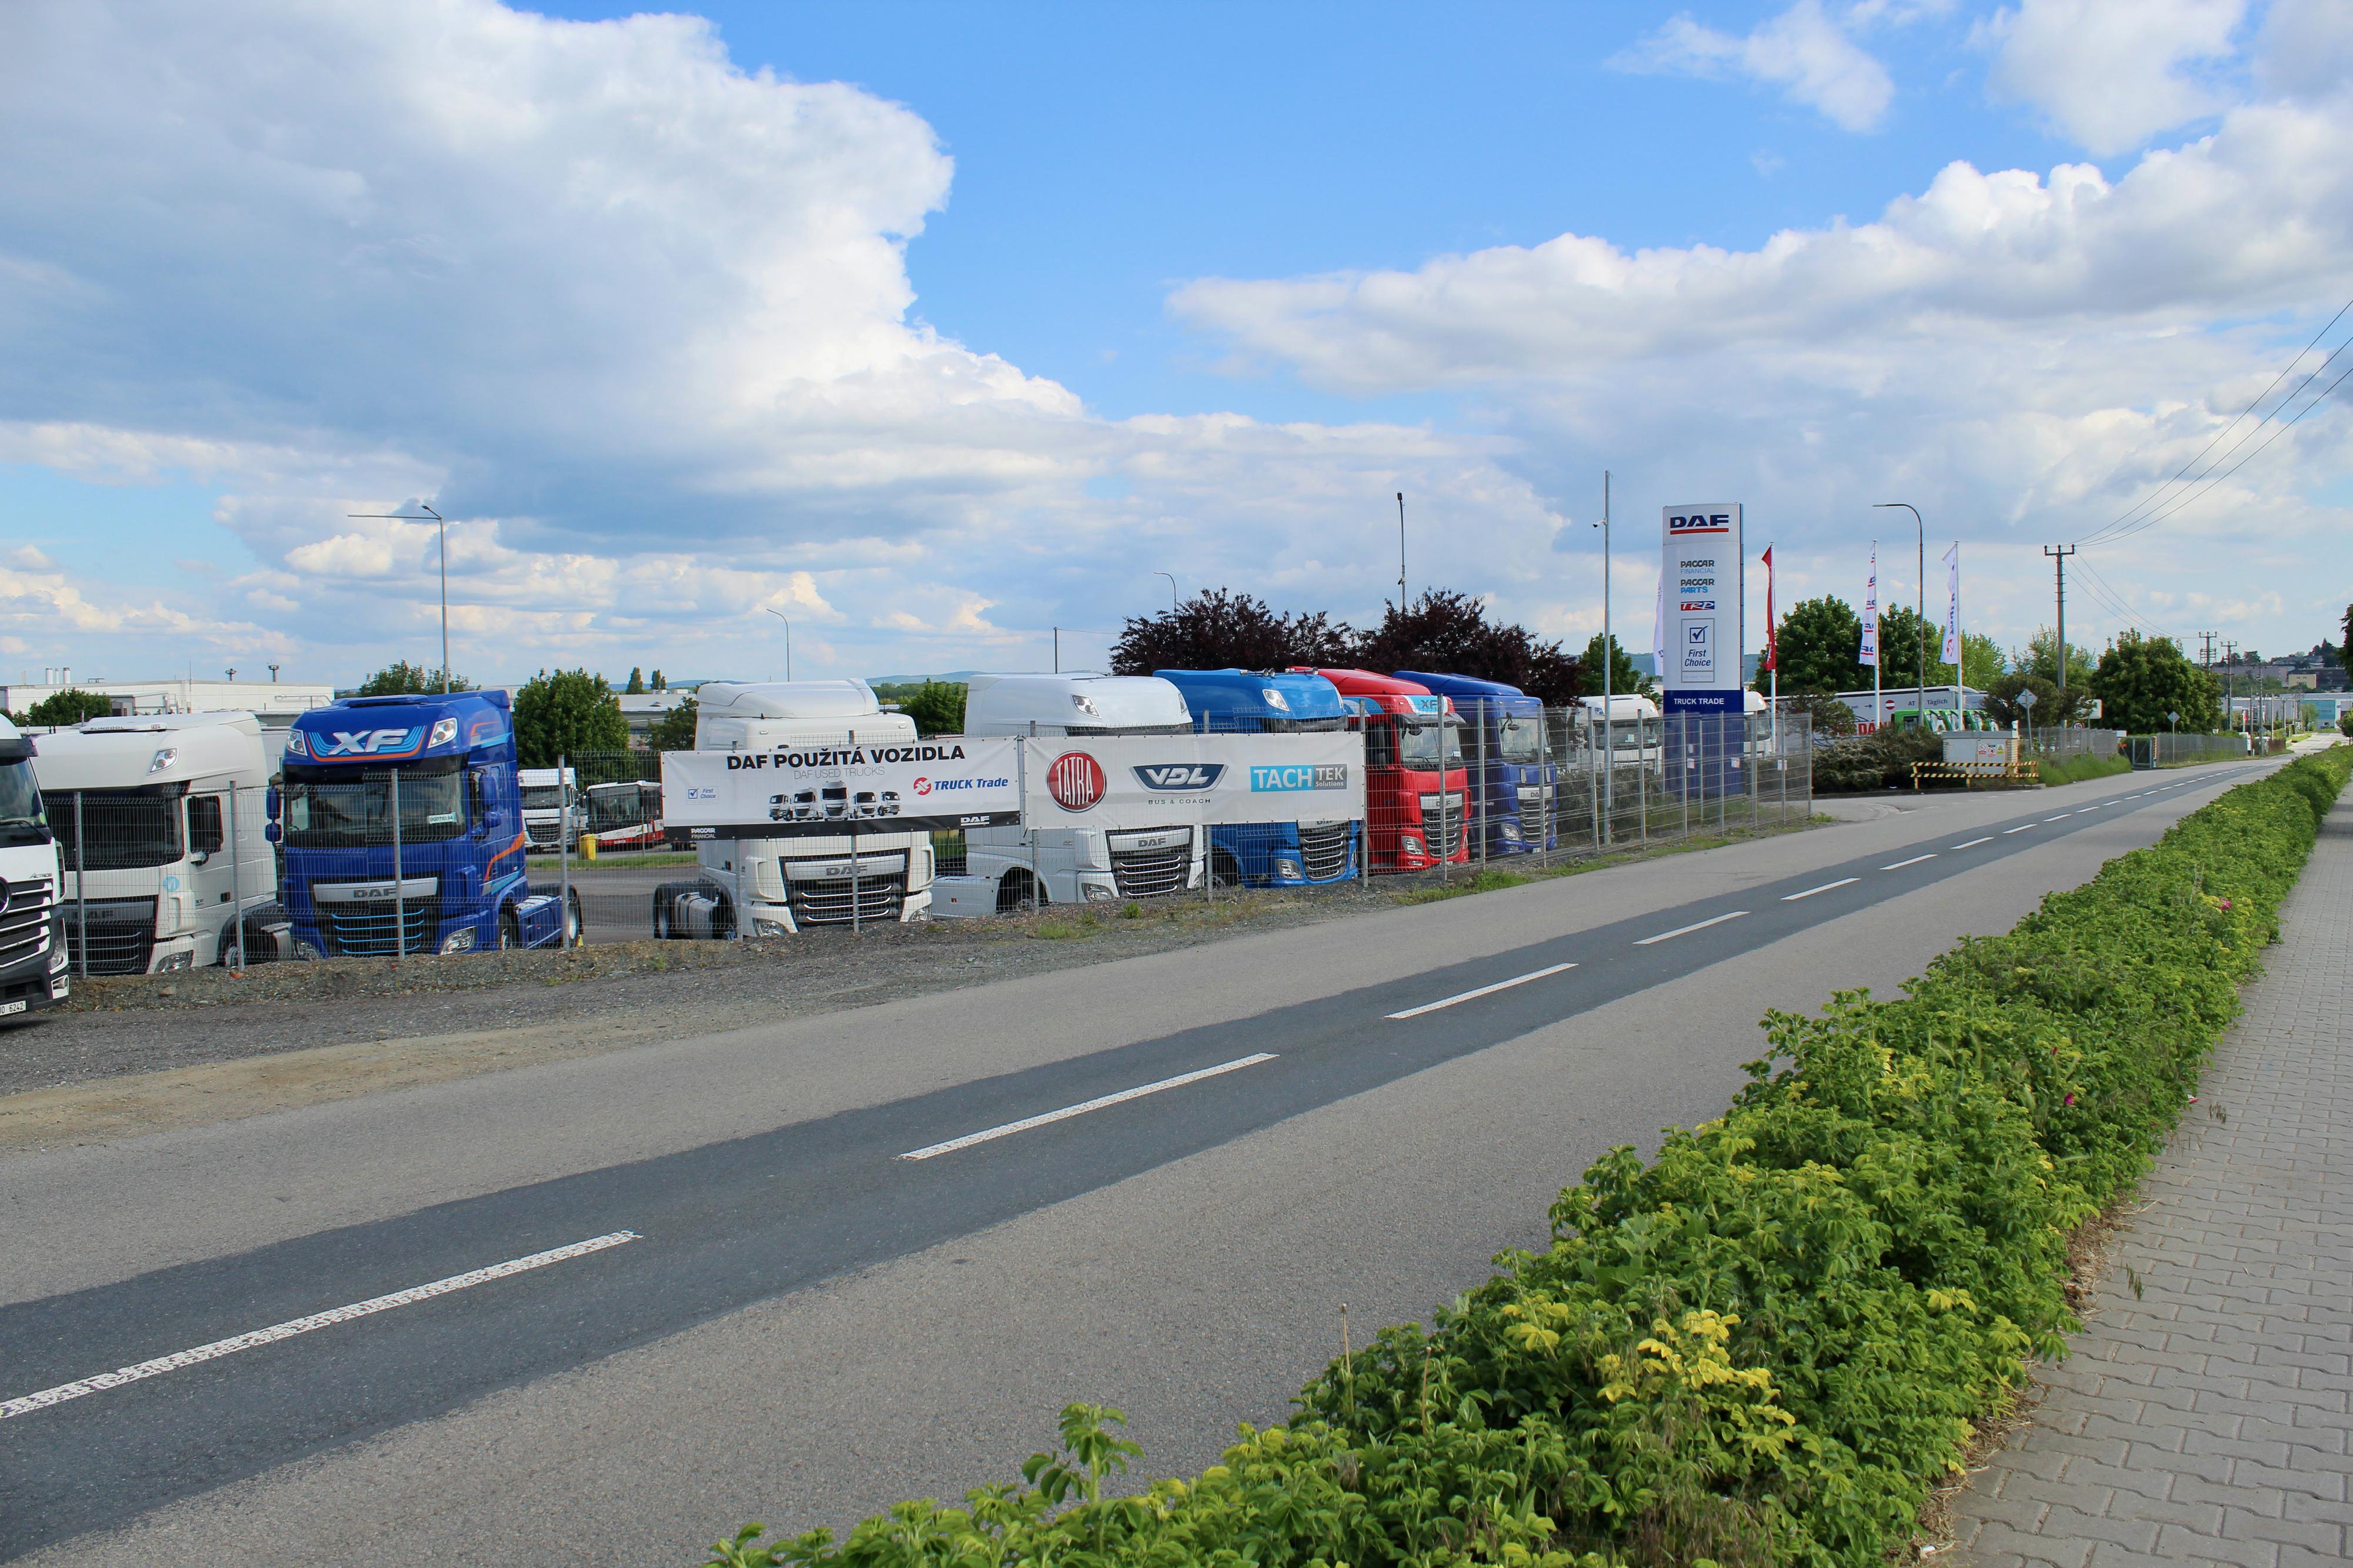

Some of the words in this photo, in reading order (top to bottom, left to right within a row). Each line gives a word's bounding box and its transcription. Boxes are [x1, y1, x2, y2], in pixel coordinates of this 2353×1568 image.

[1670, 515, 1729, 529] DAF
[1681, 602, 1715, 610] TRP
[327, 729, 409, 755] XF
[727, 755, 767, 770] DAF
[774, 746, 866, 768] POUŽITÁ
[871, 745, 965, 763] VOZIDLA
[794, 770, 813, 779] DAF
[815, 768, 841, 778] USED
[844, 766, 885, 777] TRUCKS
[1145, 767, 1210, 786] VDL
[935, 779, 972, 790] TRUCK
[976, 778, 1008, 788] Trade
[1056, 756, 1094, 806] TATRA
[1138, 838, 1166, 848] DAF
[9, 1002, 24, 1012] 6242
